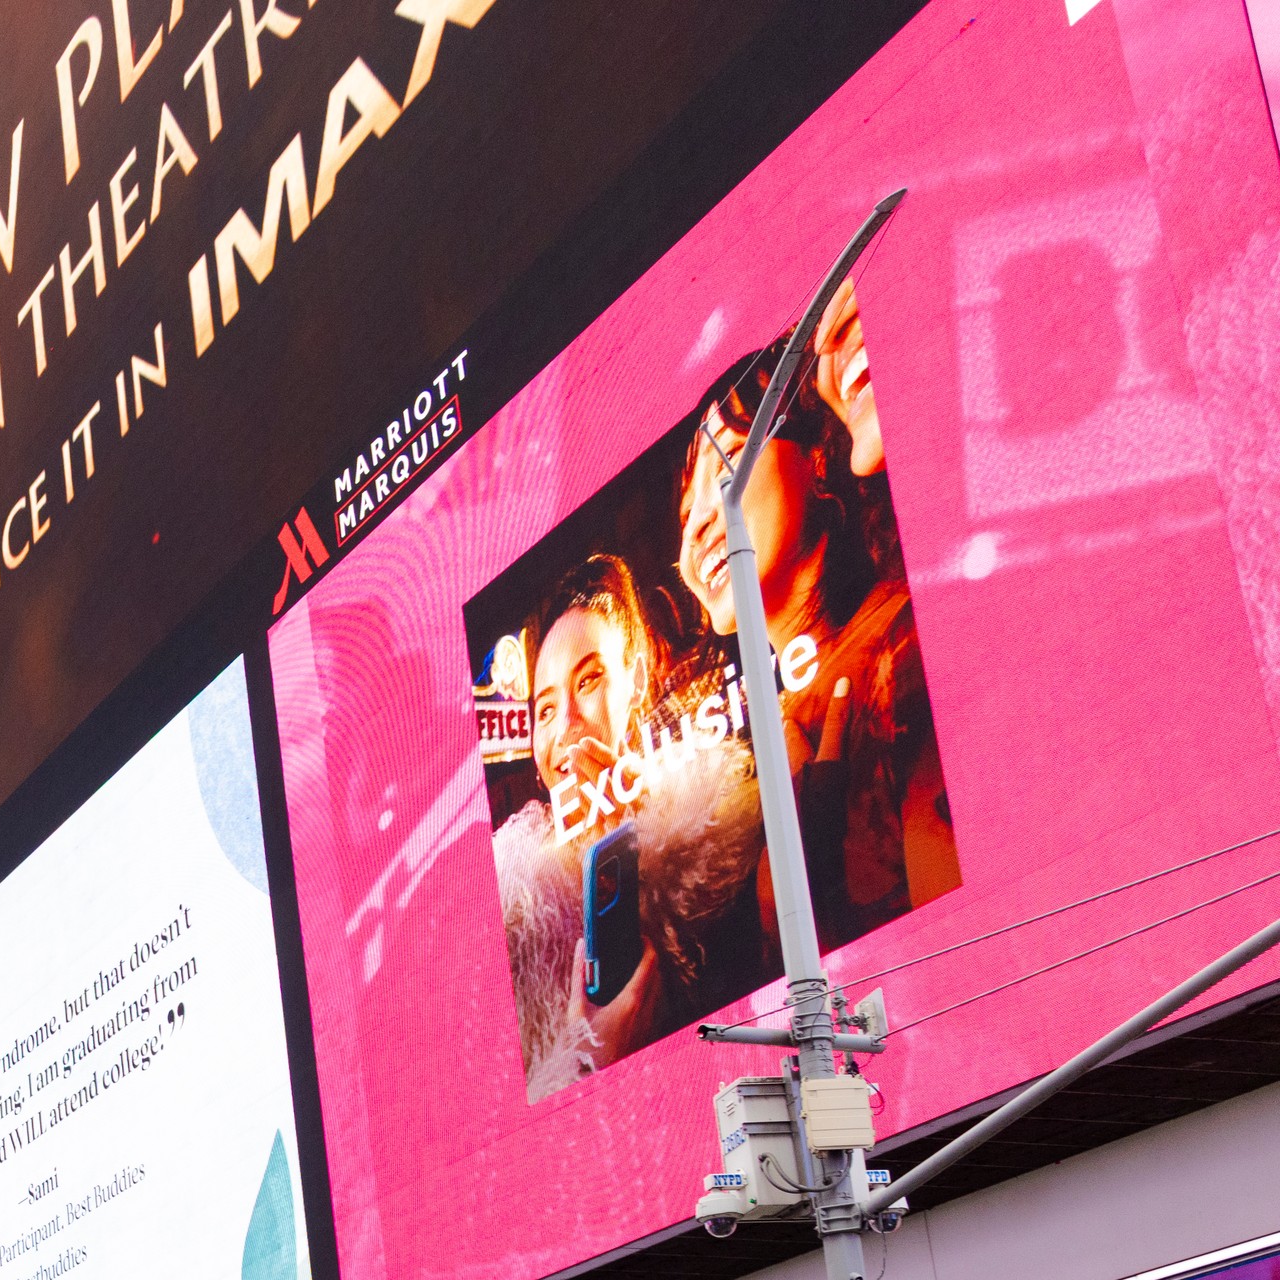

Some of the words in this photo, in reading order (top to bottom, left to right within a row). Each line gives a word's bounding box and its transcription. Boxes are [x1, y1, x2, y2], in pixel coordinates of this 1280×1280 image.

[55, 0, 184, 186] PL
[61, 401, 100, 504] IT
[115, 322, 167, 437] IN
[188, 0, 497, 358] IMAX
[333, 349, 472, 504] MARRIOTT
[338, 405, 459, 541] MARQUIS
[550, 631, 819, 848] Exclusie
[27, 1072, 35, 1098] I
[36, 1061, 60, 1091] am
[61, 997, 151, 1077] graduating
[153, 955, 199, 1006] from
[63, 989, 89, 1025] but
[89, 959, 126, 1001] that
[7, 1108, 48, 1154] WILL
[49, 1069, 99, 1129] attend
[714, 1173, 742, 1186] NYPD
[865, 1170, 888, 1183] YPD
[66, 1190, 92, 1218] Best
[93, 1162, 146, 1209] Buddies
